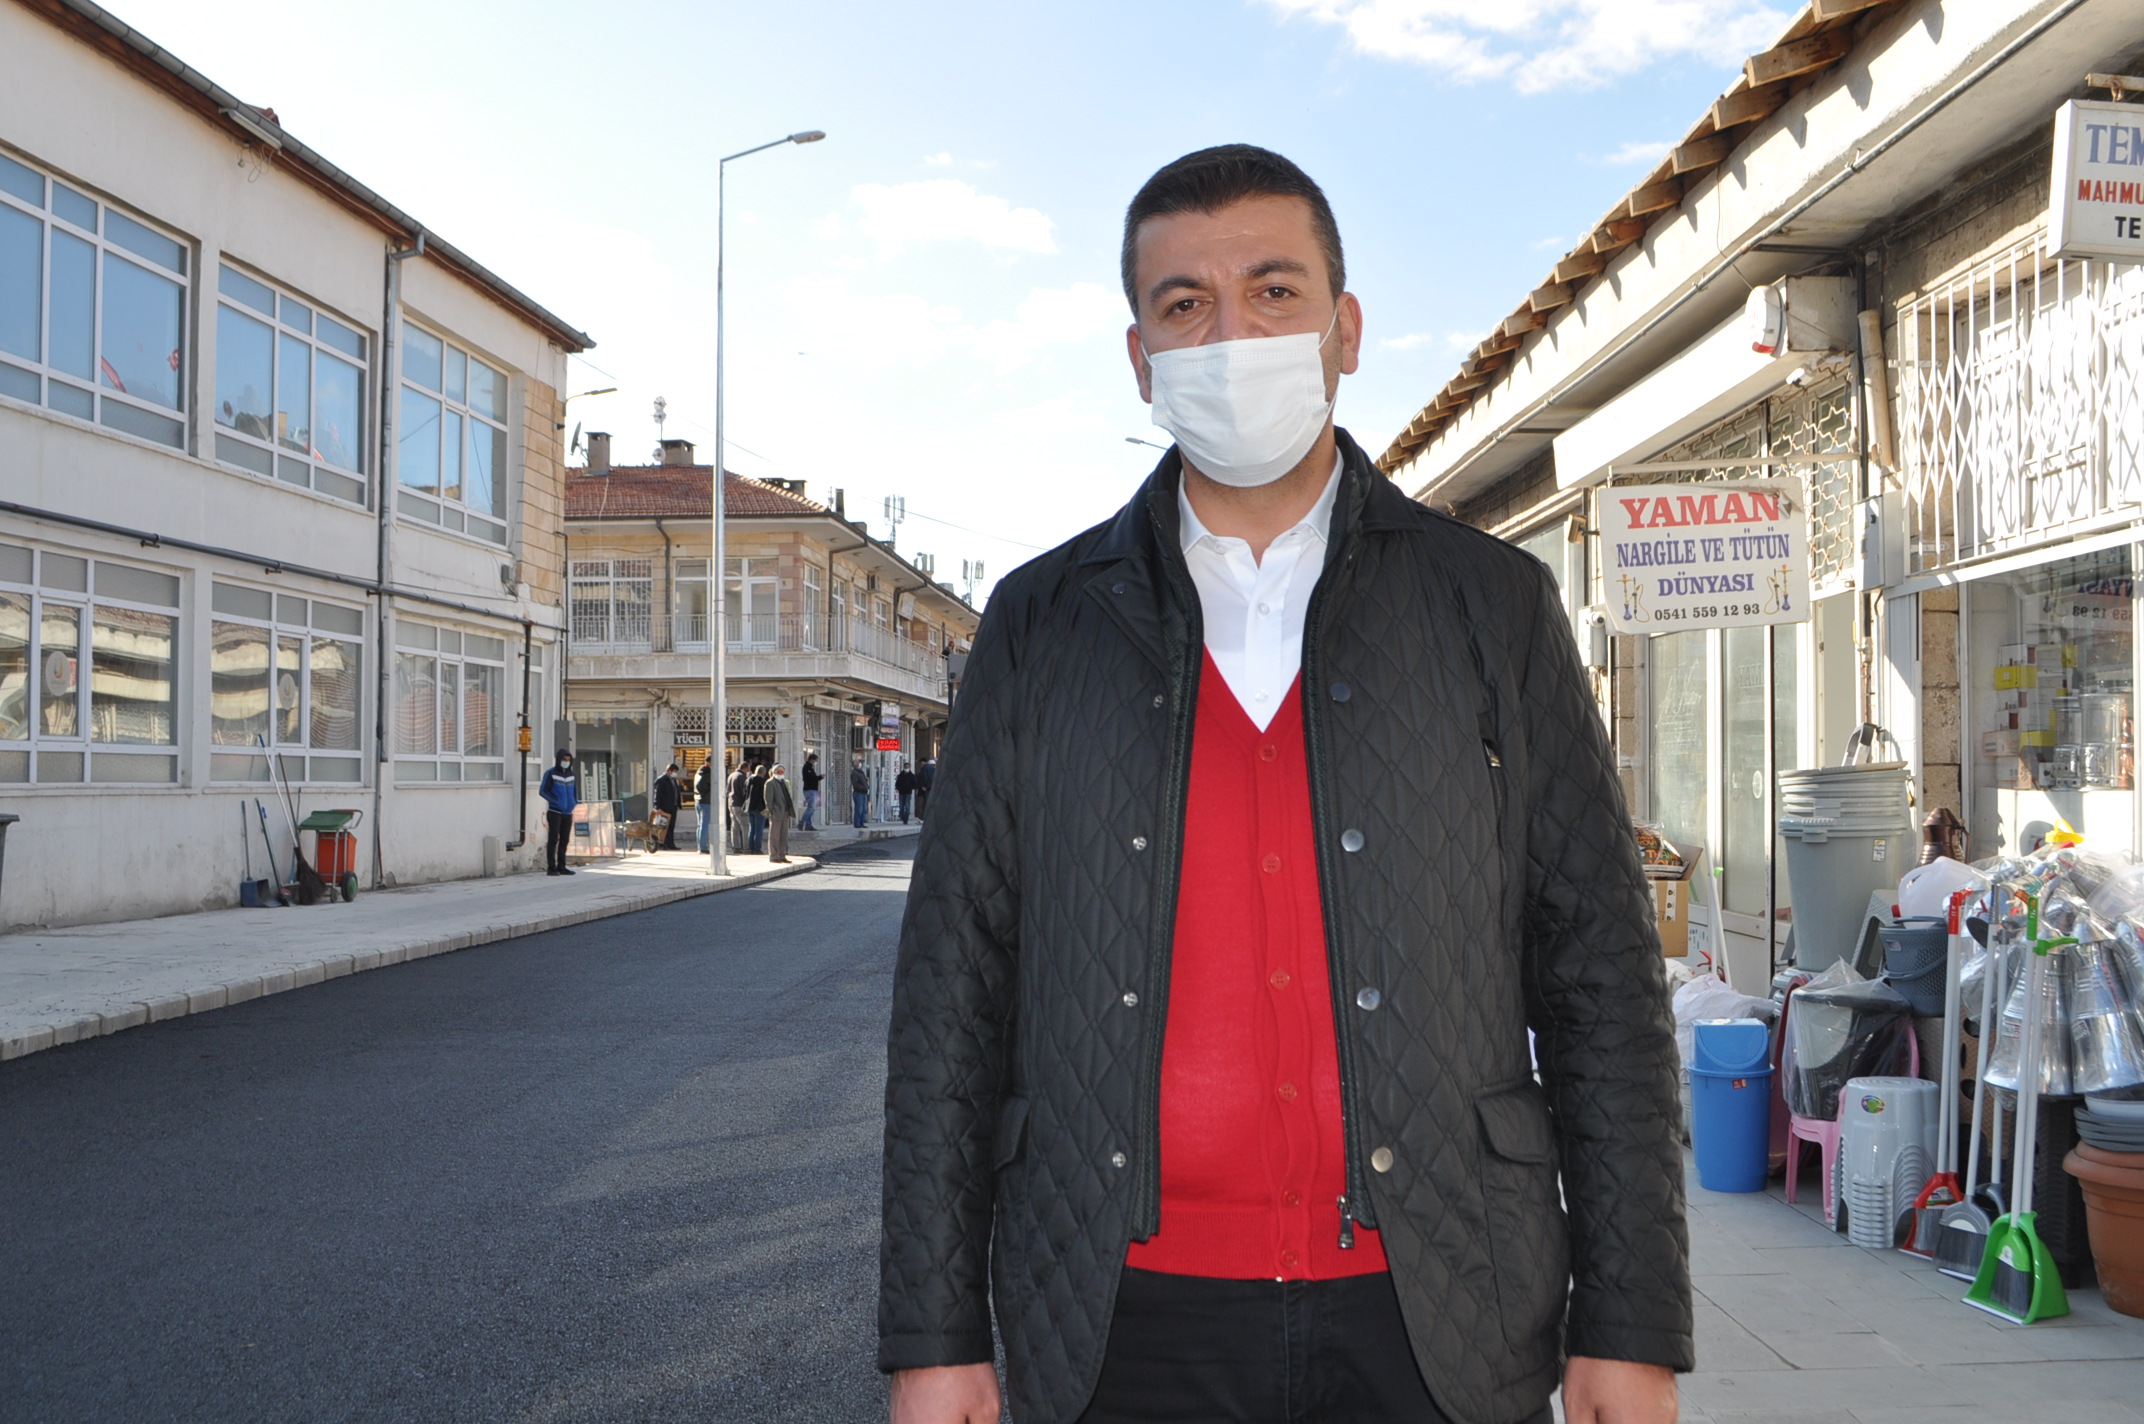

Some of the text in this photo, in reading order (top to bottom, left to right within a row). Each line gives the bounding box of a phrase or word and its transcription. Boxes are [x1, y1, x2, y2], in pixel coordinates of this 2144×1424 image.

[1619, 491, 1780, 529] YAMAN
[1616, 527, 1790, 568] NARGİLE VE TÜTÜN
[1657, 571, 1755, 597] DÜNYASI
[1654, 603, 1760, 621] 0541 559 12 93
[676, 732, 704, 744] YÜCEL
